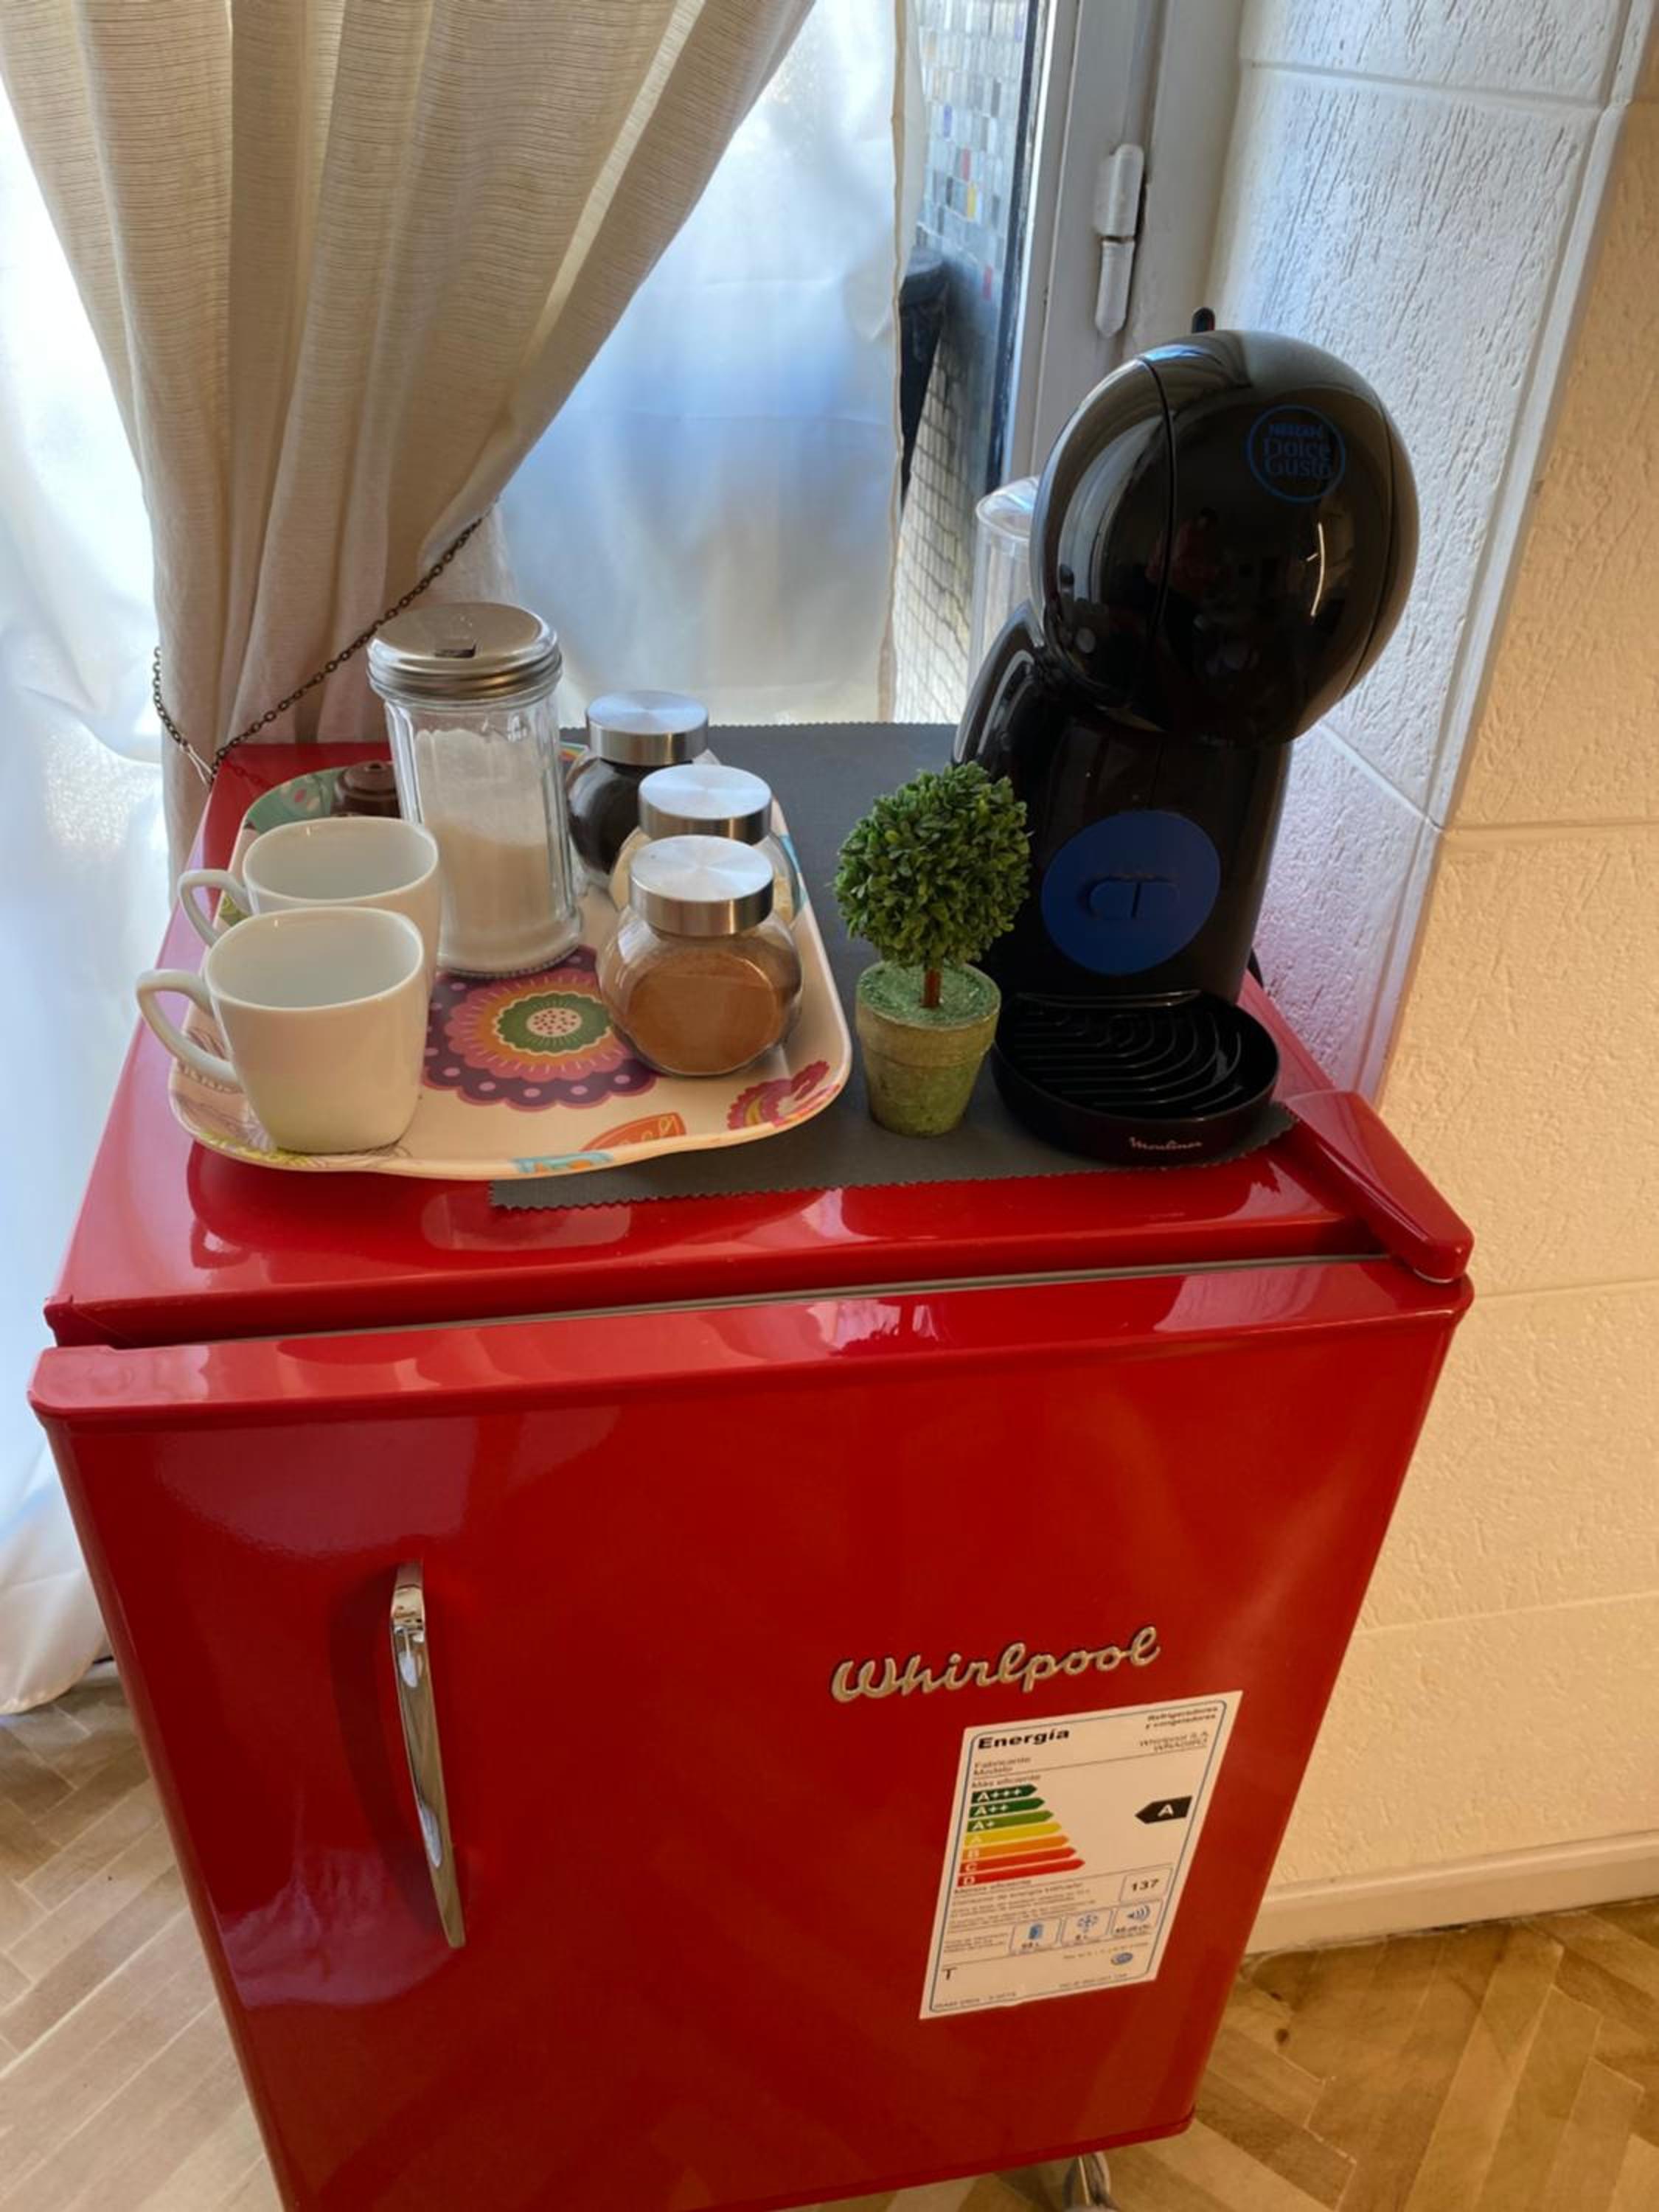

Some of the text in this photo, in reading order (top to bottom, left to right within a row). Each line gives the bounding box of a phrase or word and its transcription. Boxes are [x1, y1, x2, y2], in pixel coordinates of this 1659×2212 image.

[831, 1626, 1161, 1703] Whirlpool
[978, 1728, 1070, 1750] Energía
[977, 1789, 1022, 1802] A+++
[974, 1804, 1009, 1817] A++
[1157, 1804, 1175, 1818] A
[972, 1820, 995, 1831] A+
[964, 1862, 978, 1871] C
[963, 1875, 975, 1885] D
[1132, 1879, 1160, 1892] 137
[942, 1966, 958, 1980] T
